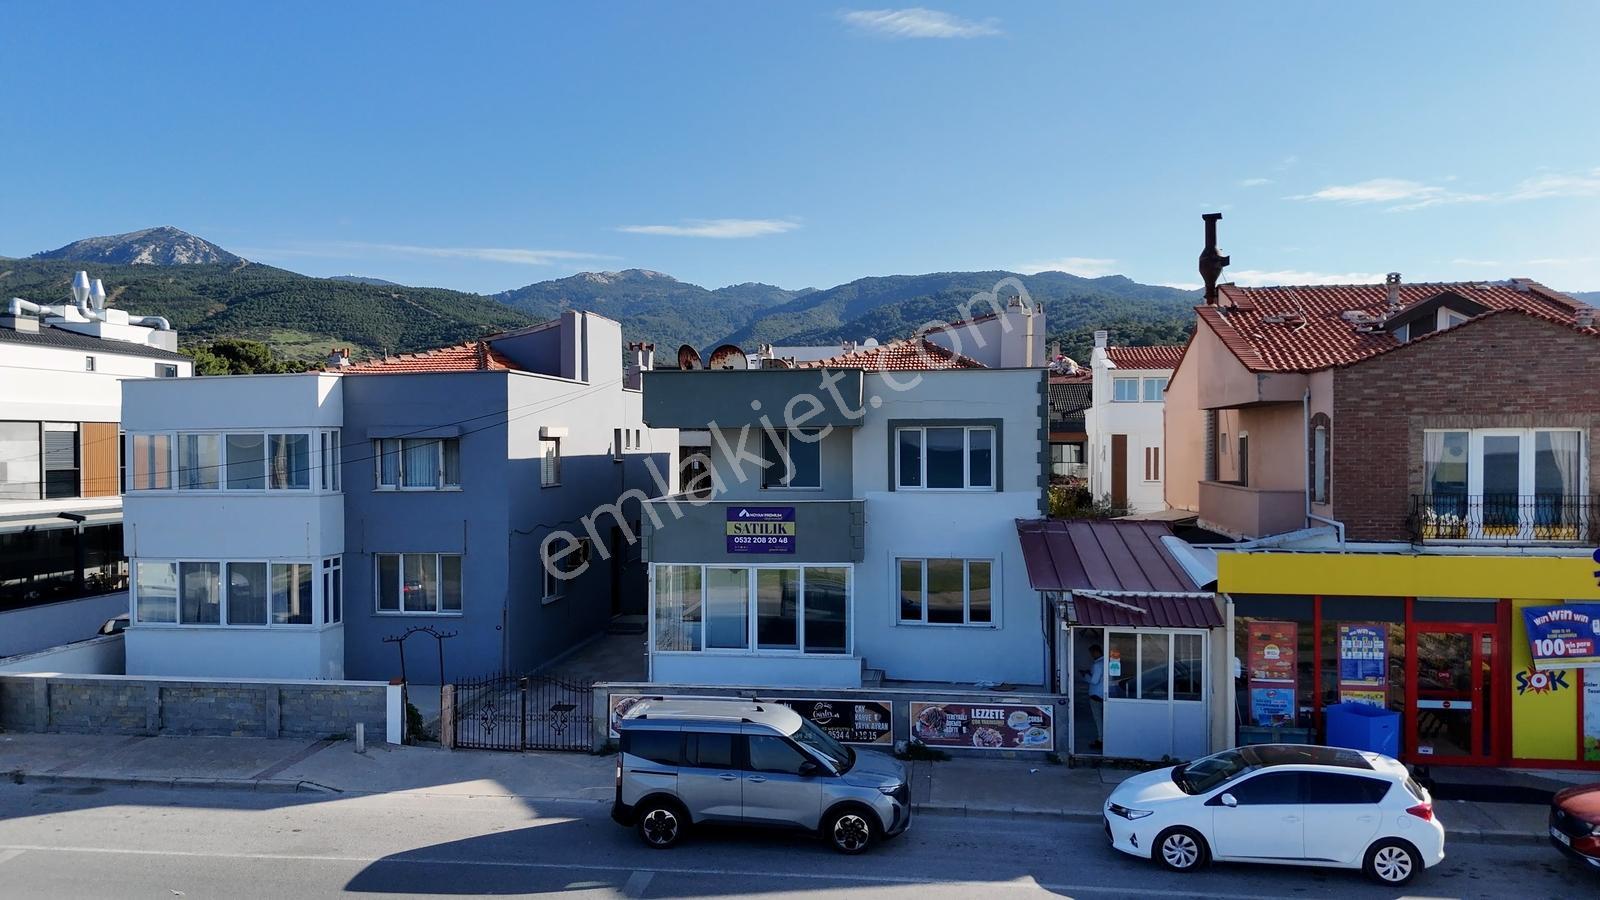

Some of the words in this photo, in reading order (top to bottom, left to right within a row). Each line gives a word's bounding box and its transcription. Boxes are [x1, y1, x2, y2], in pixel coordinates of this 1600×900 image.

[734, 523, 787, 534] SATILIK
[1535, 638, 1565, 656] 100
[1516, 671, 1570, 696] ŞOK
[971, 708, 1005, 719] LEZZETE
